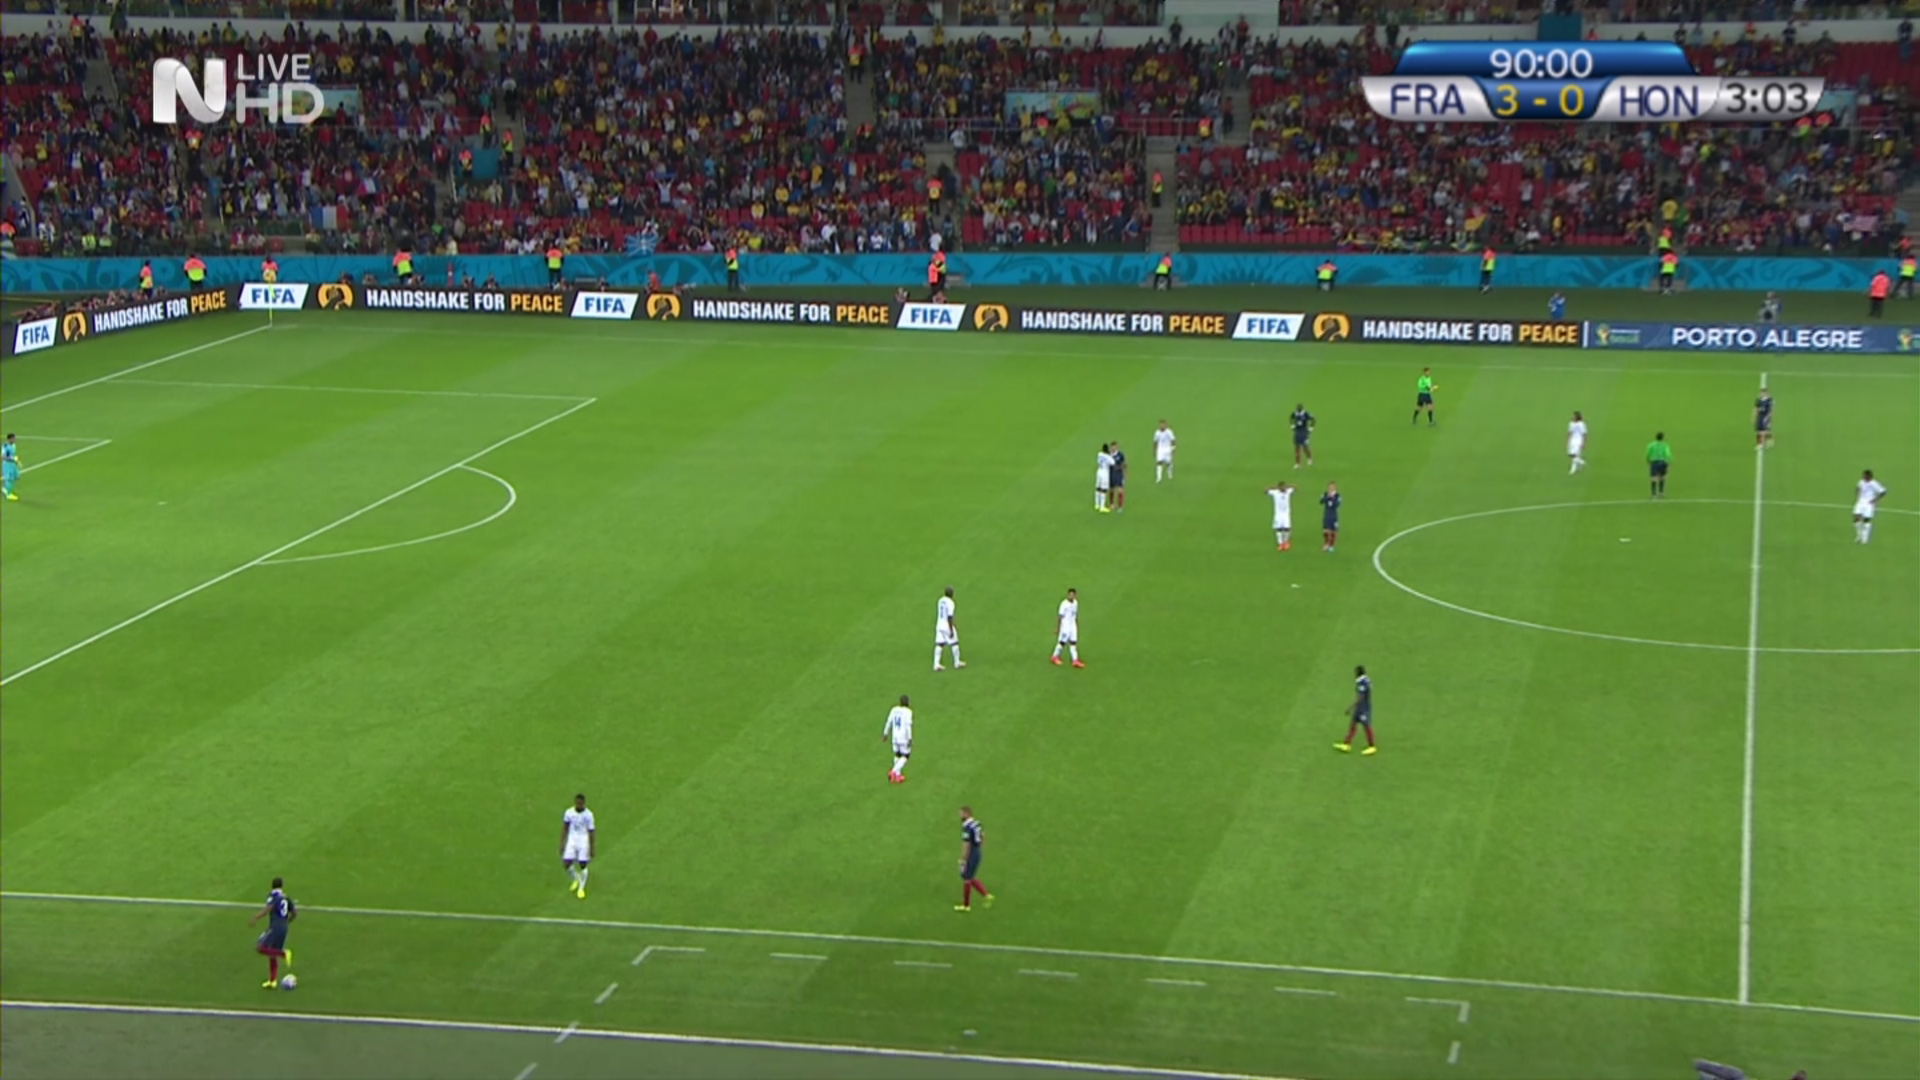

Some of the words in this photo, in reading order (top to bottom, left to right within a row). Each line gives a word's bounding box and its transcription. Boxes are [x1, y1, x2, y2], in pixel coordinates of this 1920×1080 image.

[252, 287, 296, 304] FIFA
[366, 289, 470, 310] HANDSHAKE
[474, 292, 505, 311] FOR
[510, 293, 563, 313] PEACE
[584, 297, 626, 313] FIFA
[94, 305, 164, 333] HANDSHAKE
[166, 298, 188, 319] FOR
[190, 290, 226, 314] PEACE
[693, 300, 795, 321] HANDSHAKE
[799, 303, 831, 322] FOR
[836, 304, 889, 324] PEACE
[910, 308, 953, 324] FIFA
[1022, 311, 1126, 332] HANDSHAKE
[1130, 314, 1163, 332] FOR
[1169, 315, 1225, 334] PEACE
[22, 325, 51, 347] FIFA
[1246, 318, 1291, 335] FIFA
[1362, 320, 1474, 341] HANDSHAKE
[1478, 323, 1514, 342] FOR
[1518, 324, 1578, 343] PEACE
[1671, 327, 1757, 347] PORTO
[1763, 328, 1863, 349] ALEGRE
[280, 899, 289, 917] 3
